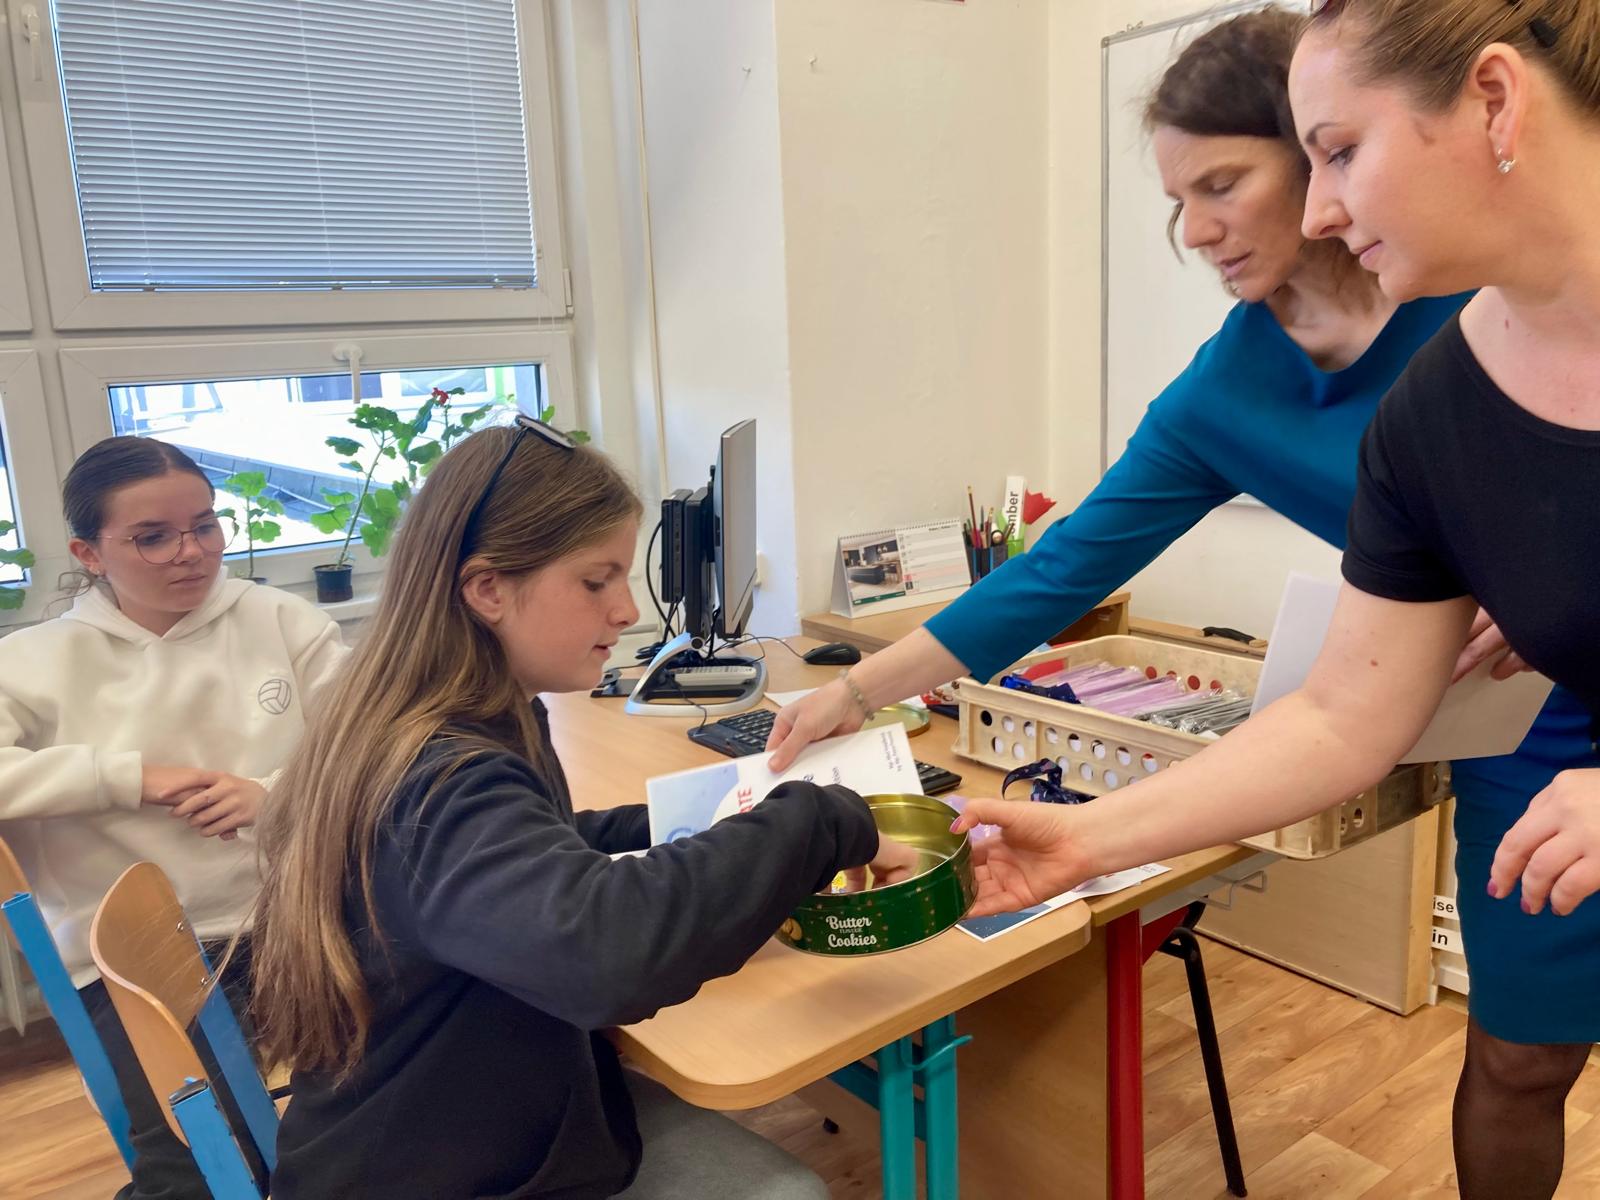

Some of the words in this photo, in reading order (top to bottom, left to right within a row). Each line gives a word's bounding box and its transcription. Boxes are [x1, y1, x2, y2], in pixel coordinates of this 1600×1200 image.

[1006, 491, 1018, 539] mber
[825, 915, 872, 930] Butter
[828, 933, 877, 948] Cookies
[1432, 929, 1448, 946] in
